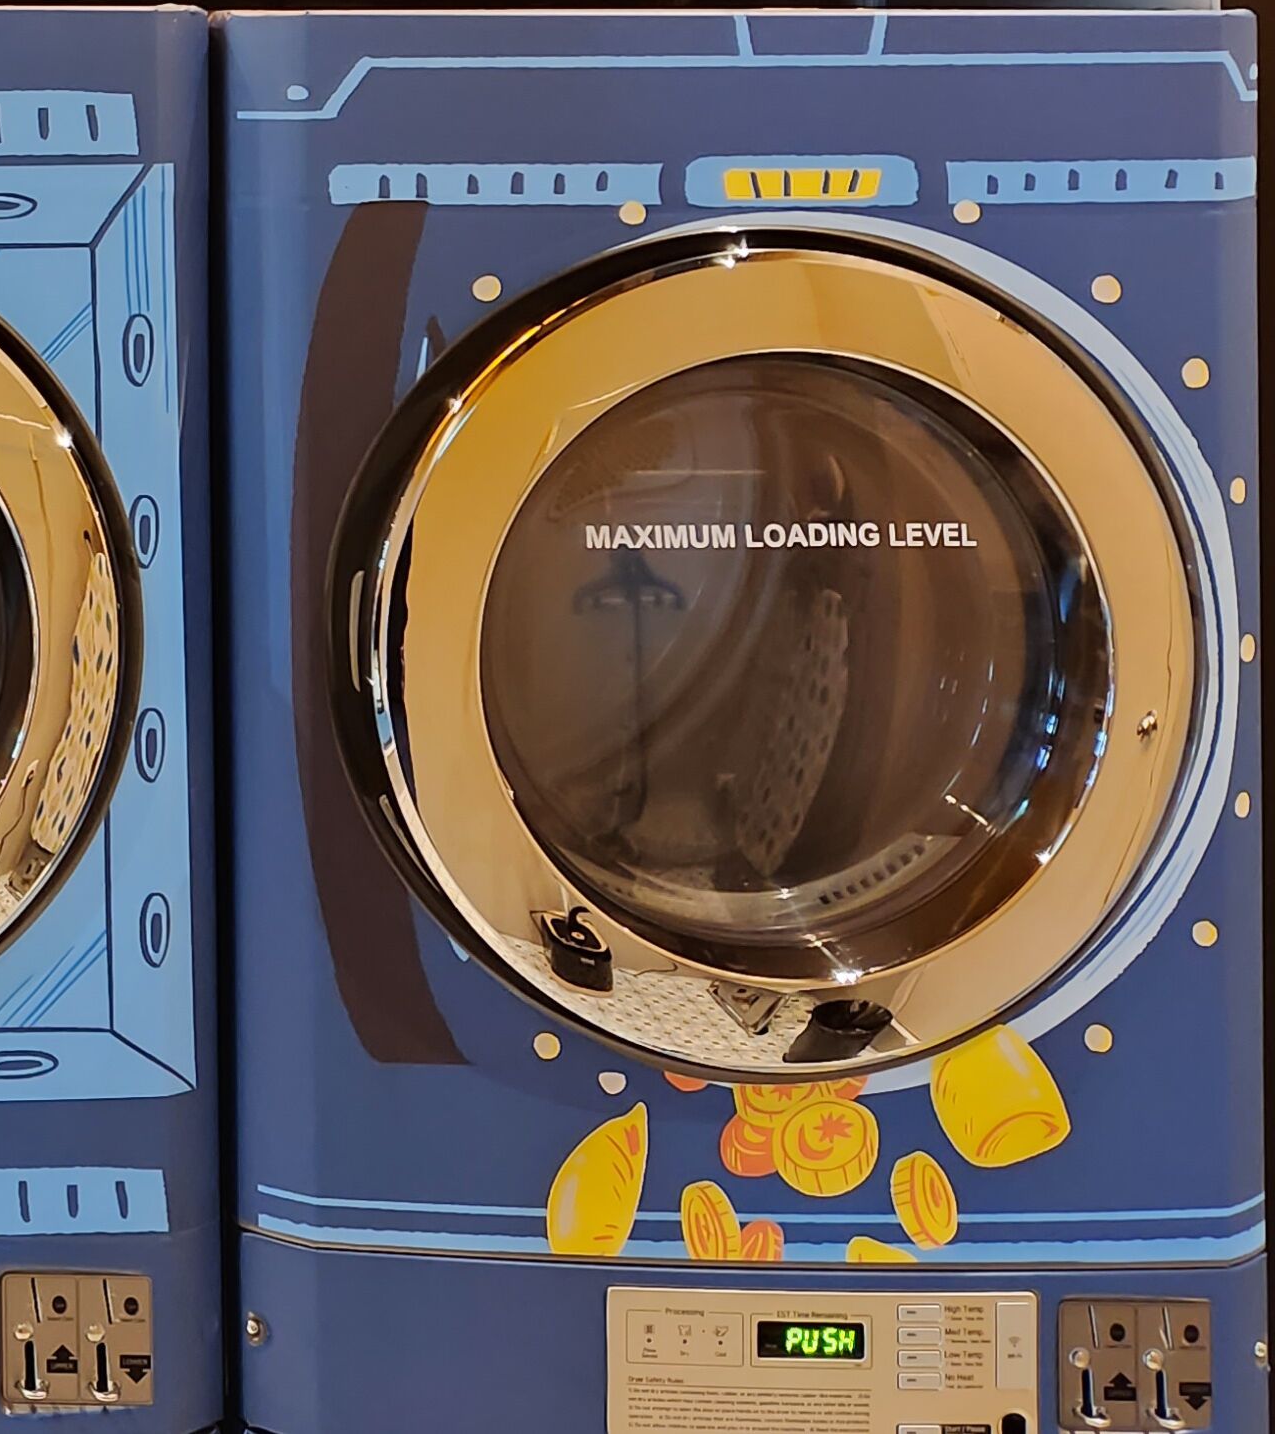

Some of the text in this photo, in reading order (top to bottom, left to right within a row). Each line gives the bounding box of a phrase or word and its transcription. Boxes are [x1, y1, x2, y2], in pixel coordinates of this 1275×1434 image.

[585, 522, 978, 549] MAXIMUM LOADING LEVEL
[963, 1305, 984, 1314] Temp
[963, 1328, 984, 1337] Temp
[785, 1326, 856, 1355] PUSH
[944, 1351, 984, 1360] Low Temp
